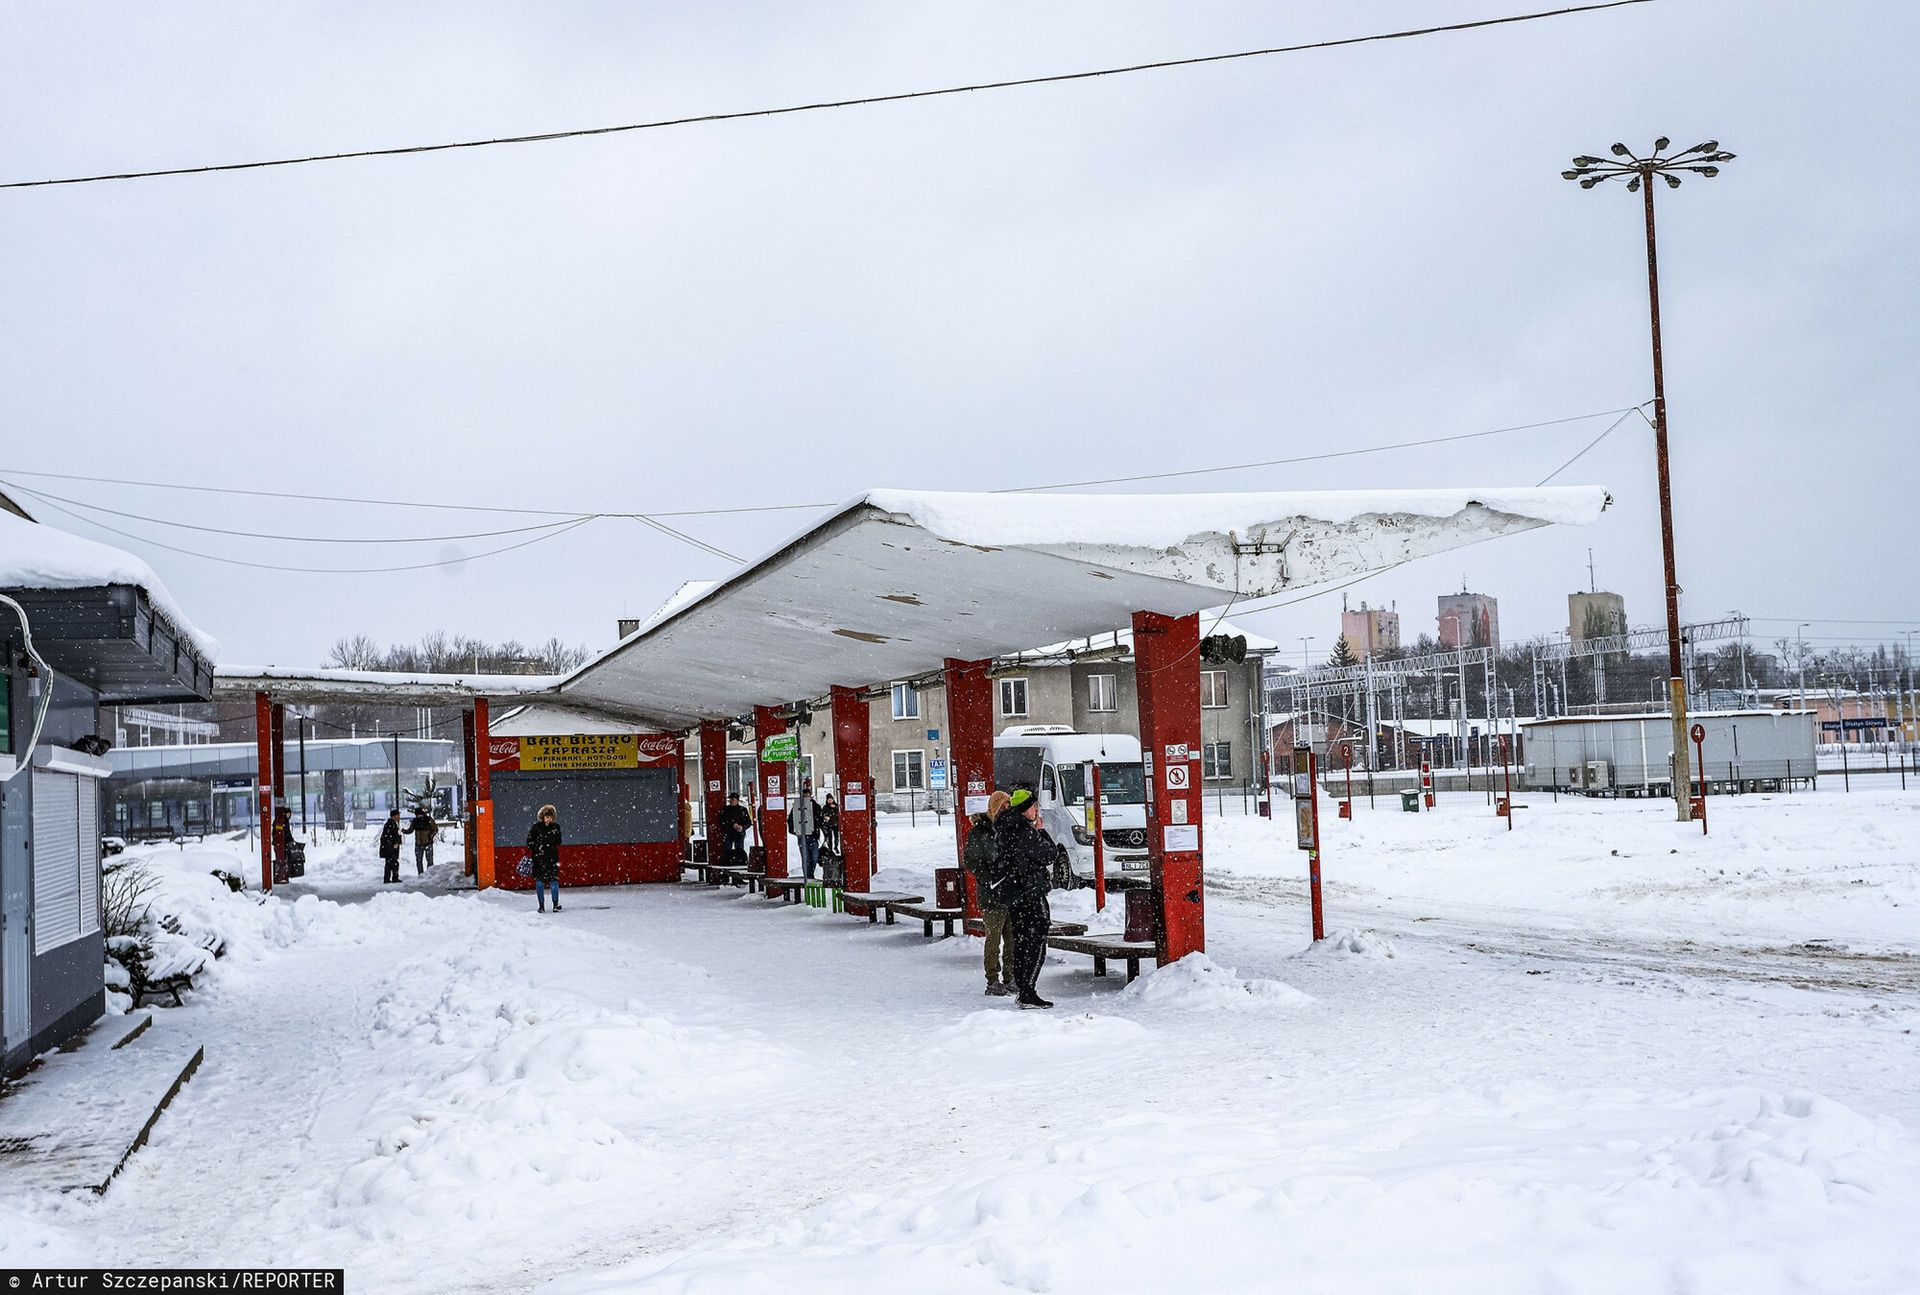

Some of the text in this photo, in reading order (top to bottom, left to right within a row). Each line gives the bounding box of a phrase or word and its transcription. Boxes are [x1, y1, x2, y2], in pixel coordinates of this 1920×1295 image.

[1694, 726, 1701, 739] 4
[527, 734, 631, 746] BAR BISTRO
[543, 746, 616, 755] ZAPRASZA
[1343, 746, 1349, 757] 2
[931, 760, 945, 768] TAXI
